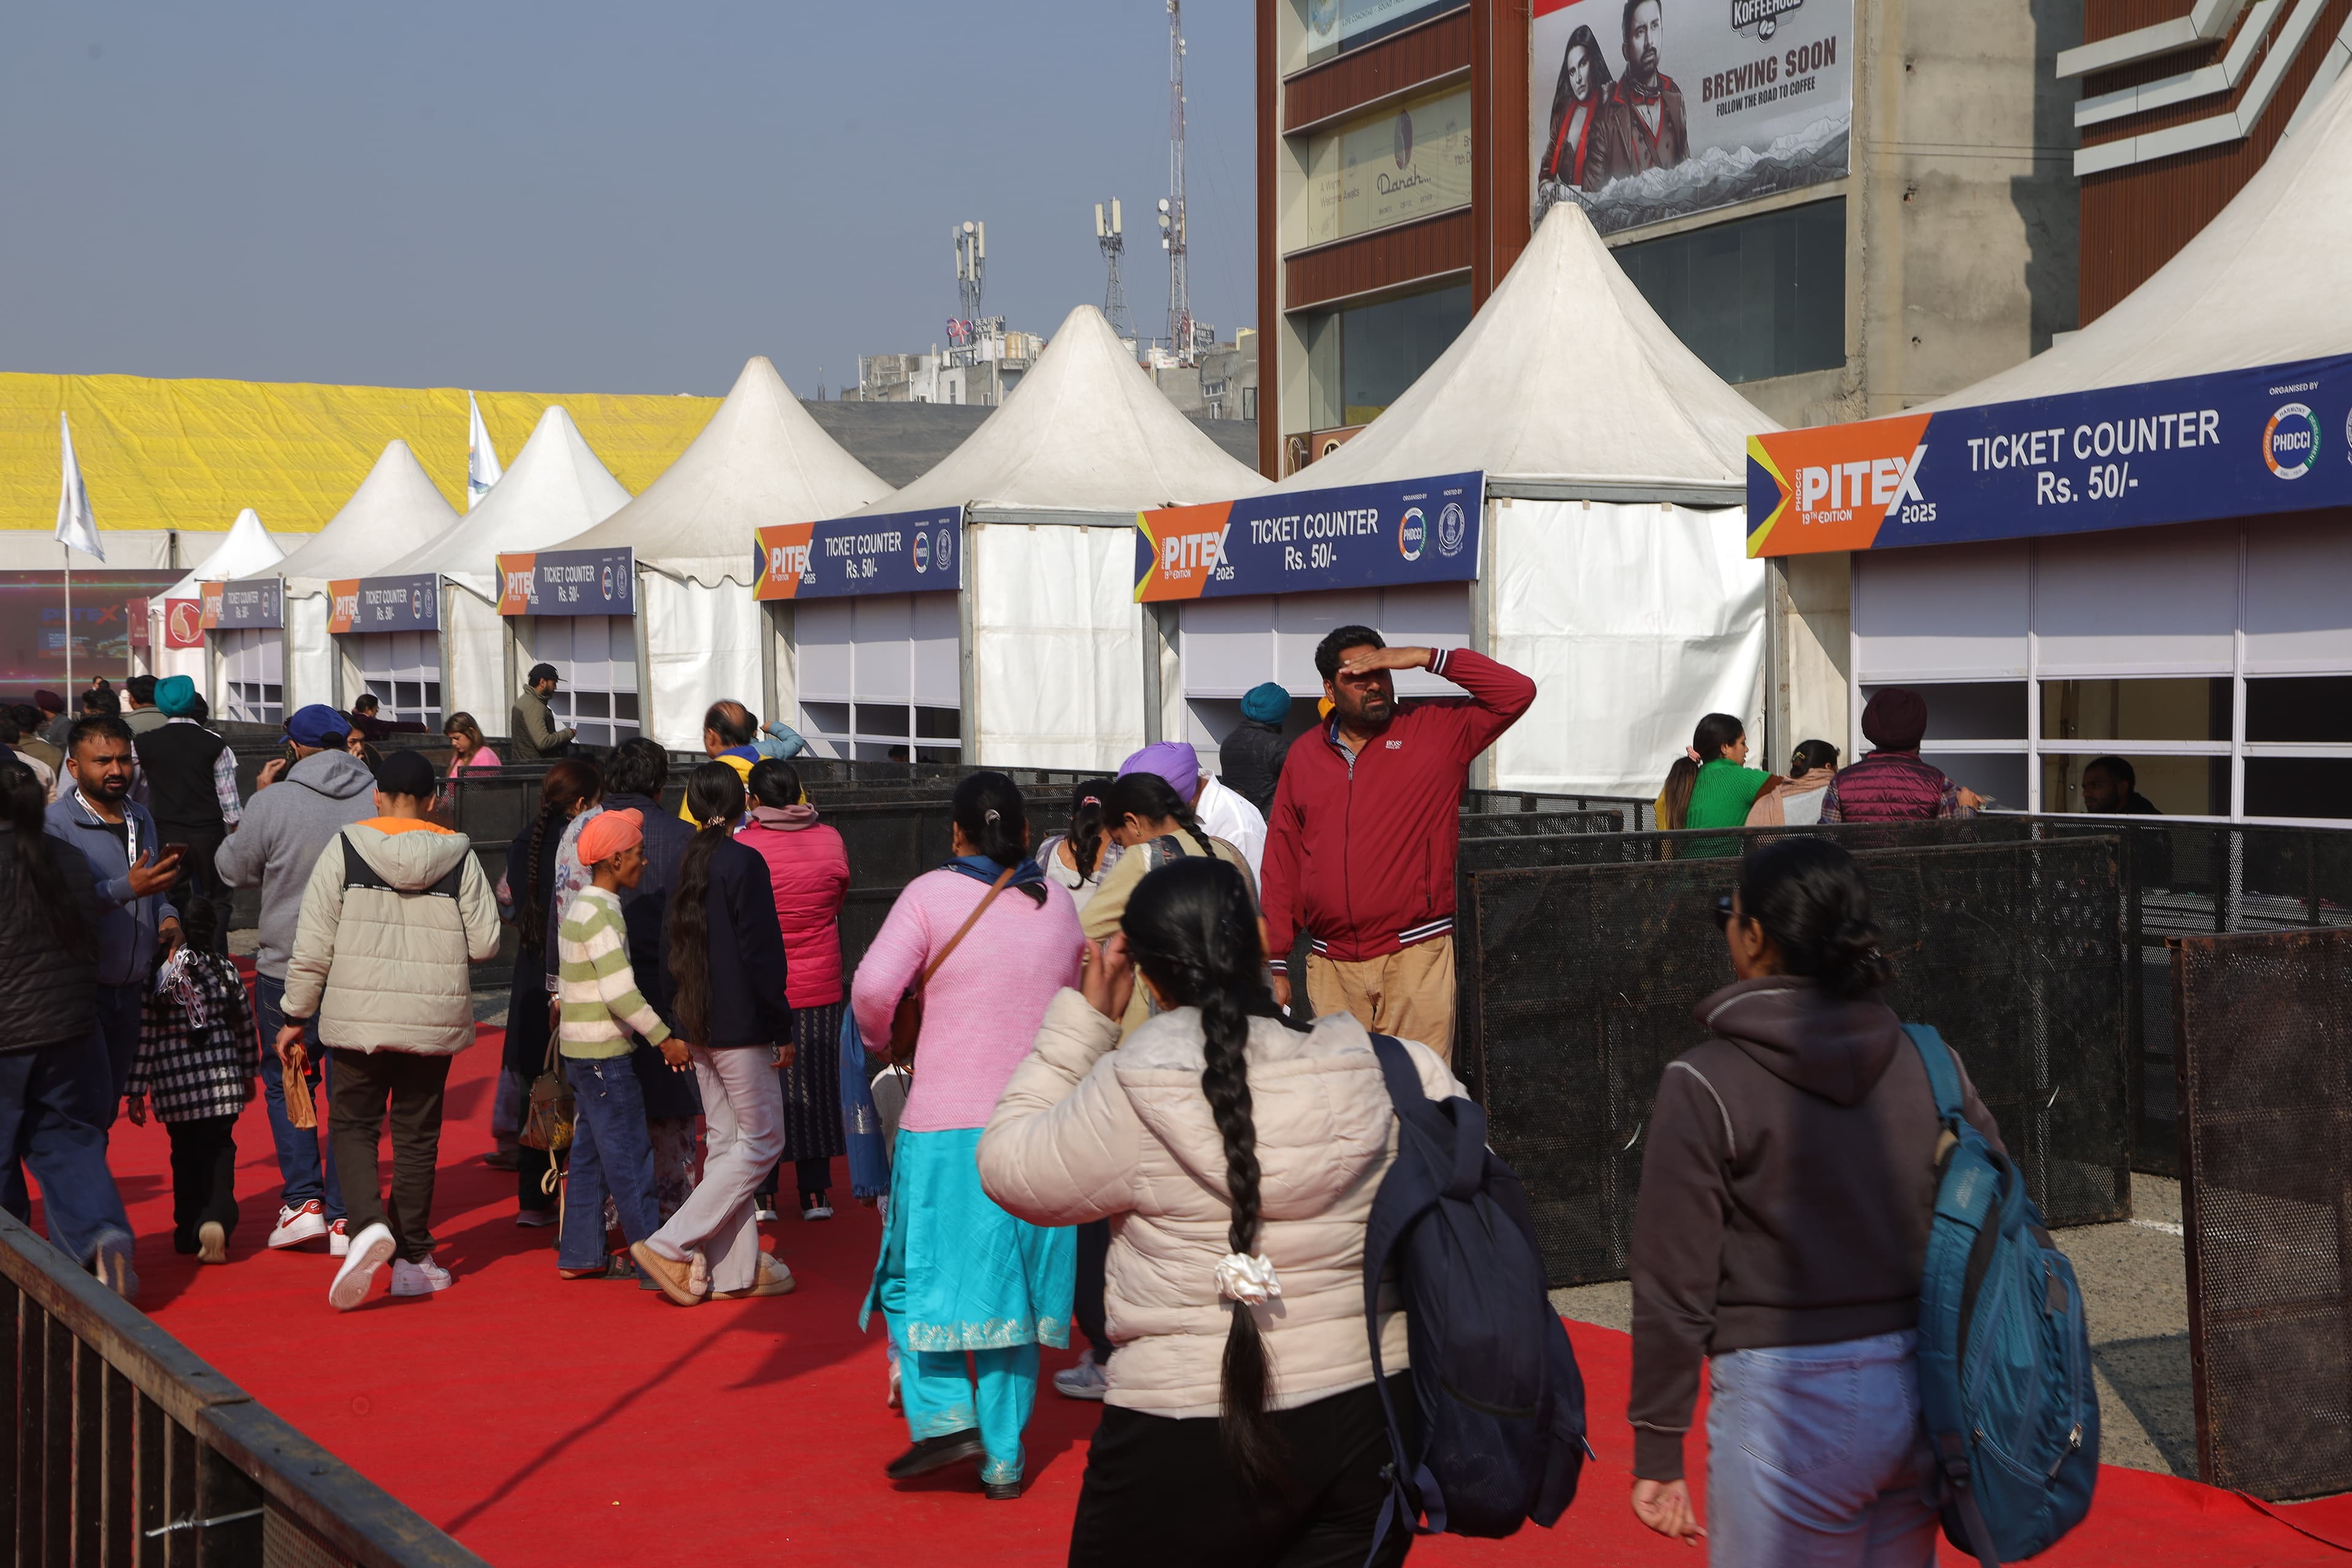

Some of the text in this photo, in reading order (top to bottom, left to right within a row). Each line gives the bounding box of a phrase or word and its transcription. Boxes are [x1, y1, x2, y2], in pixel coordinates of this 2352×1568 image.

[1703, 36, 1836, 103] BREWING SOON
[1716, 76, 1815, 117] FOLLOW THE ROAD TO COFFEE
[2269, 381, 2319, 395] ORGANISED BY
[2280, 406, 2305, 417] HARMONY
[1967, 409, 2220, 471] TICKET COUNTER
[2273, 431, 2310, 452] PHDCCI
[1803, 444, 1928, 516] PITEX
[2037, 461, 2138, 505] Rs. 50/-
[1902, 503, 1937, 524] 2025
[1250, 508, 1378, 544] TICKET COUNTER
[1403, 527, 1422, 541] PHDCCI
[825, 532, 902, 557] TICKET COUNTER
[1166, 523, 1231, 575] PITEX
[1284, 542, 1336, 570] Rs. 50/-
[772, 539, 813, 579] PITEX
[846, 557, 878, 579] Rs. 50/-
[508, 567, 535, 600] PITEX
[544, 565, 595, 583] TICKET COUNTER
[804, 573, 816, 584] 2025
[1216, 566, 1234, 581] 2025
[206, 593, 224, 617] PITEX
[336, 592, 359, 620] PITEX
[366, 589, 407, 605] TICKET COUNTER
[558, 586, 579, 602] Rs. 50/-
[43, 605, 120, 625] PITEX
